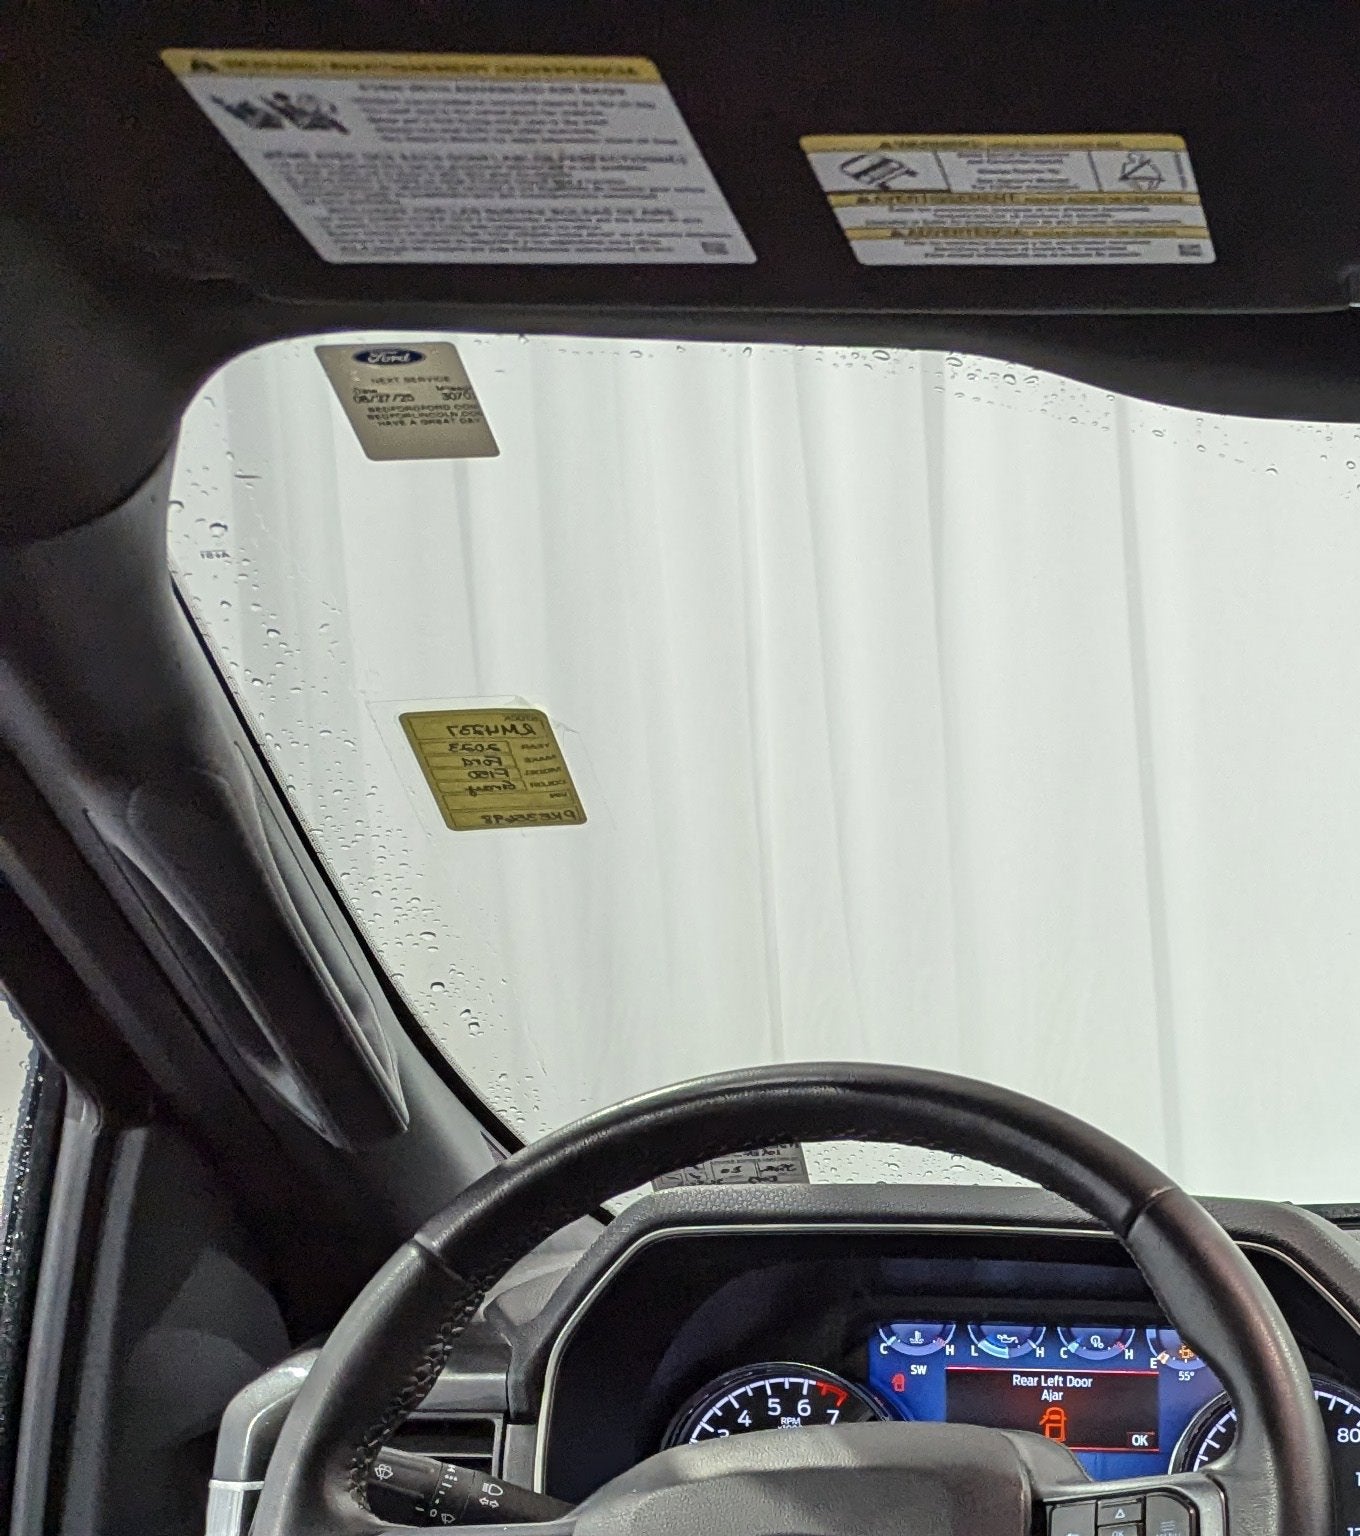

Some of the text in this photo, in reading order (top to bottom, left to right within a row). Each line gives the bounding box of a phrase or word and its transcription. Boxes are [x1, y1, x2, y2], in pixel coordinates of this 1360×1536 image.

[367, 351, 411, 363] Ford
[879, 1342, 889, 1355] C
[945, 1344, 955, 1356] H
[970, 1345, 979, 1357] L
[1035, 1346, 1045, 1358] H
[1059, 1347, 1069, 1359] C
[1124, 1348, 1134, 1360] H
[1149, 1357, 1158, 1369] E
[910, 1363, 927, 1376] SW
[1012, 1374, 1093, 1388] Rear Left Door
[1177, 1370, 1195, 1382] 55°
[1041, 1389, 1064, 1402] Ajar
[767, 1398, 781, 1416] 5
[797, 1399, 812, 1416] 6
[737, 1409, 753, 1427] 4
[780, 1416, 801, 1426] RPM
[826, 1409, 840, 1426] 7
[1131, 1434, 1150, 1447] OK
